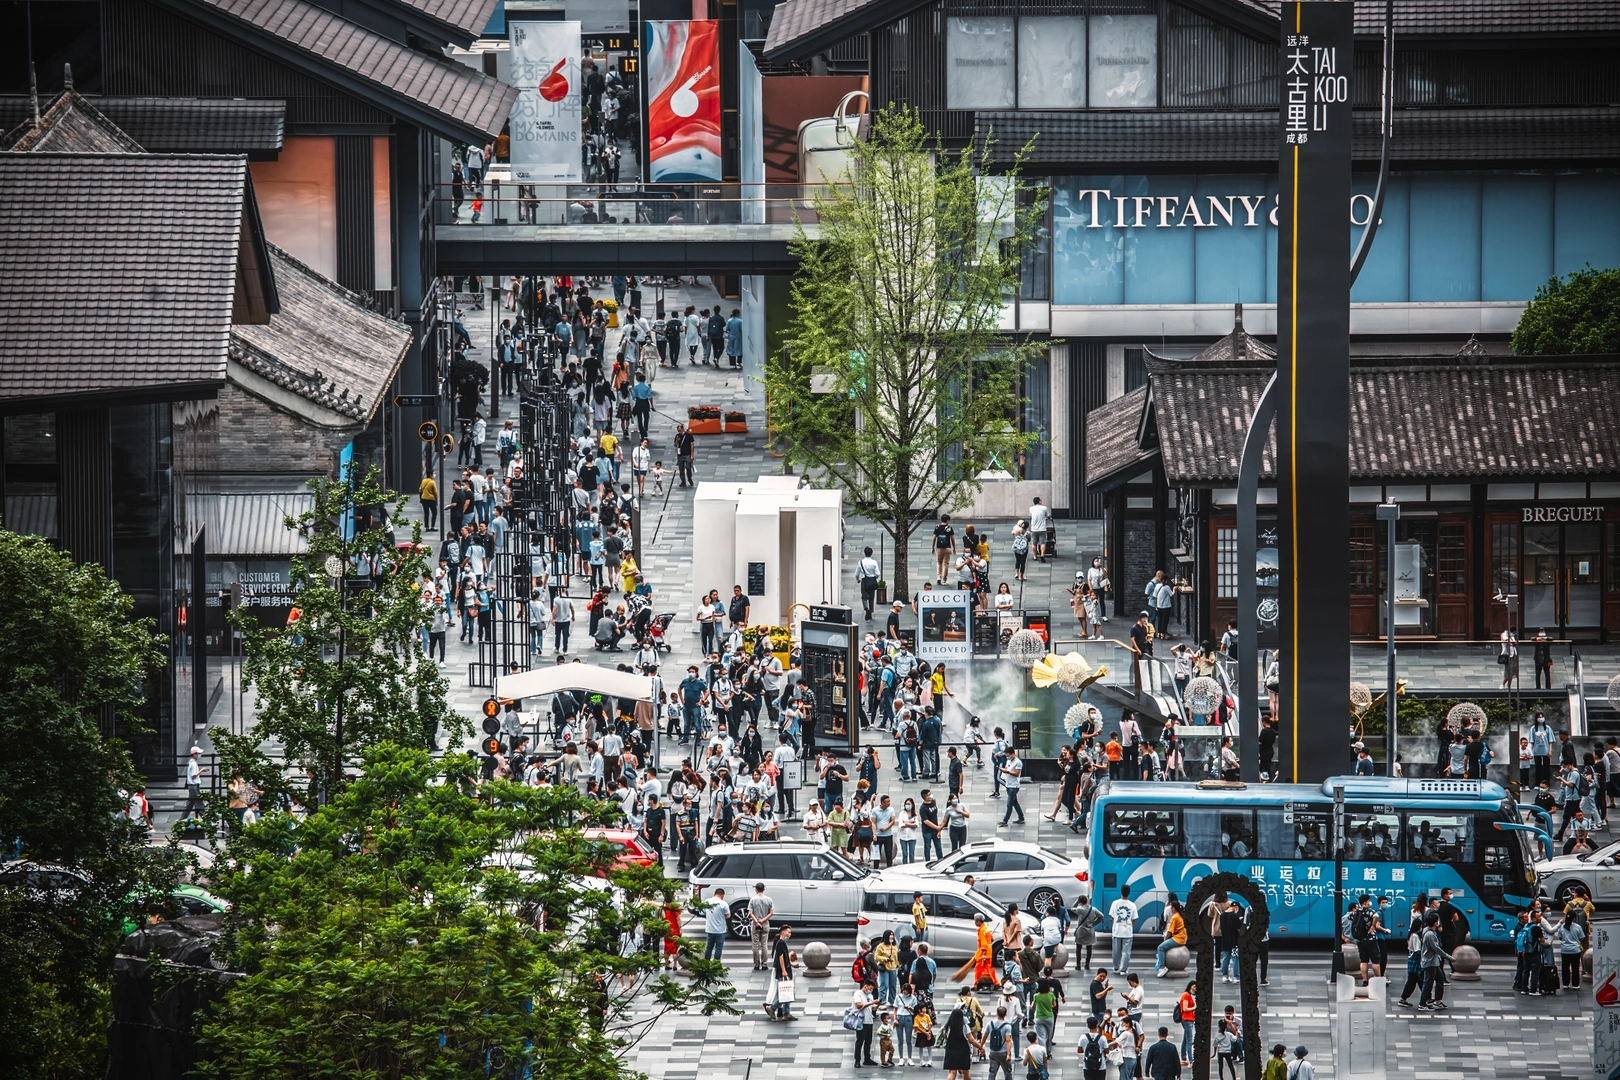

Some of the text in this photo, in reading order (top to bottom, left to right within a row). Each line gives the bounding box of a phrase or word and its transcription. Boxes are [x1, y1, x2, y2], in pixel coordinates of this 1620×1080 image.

[1287, 35, 1309, 47] 远洋
[1311, 47, 1336, 74] TAI
[1286, 48, 1309, 131] 太古里
[1314, 76, 1348, 103] KOO
[1313, 104, 1327, 131] LI
[515, 121, 536, 131] MY
[515, 131, 577, 142] DOMAINS
[1286, 133, 1308, 144] 成都
[1079, 189, 1266, 228] TIFFANY
[1522, 506, 1604, 522] BREGUET
[239, 572, 280, 582] CUSTOMER
[240, 584, 273, 594] SERVICE
[241, 596, 294, 607] 客户服务中
[922, 594, 966, 603] GUCCI
[490, 740, 498, 752] 9
